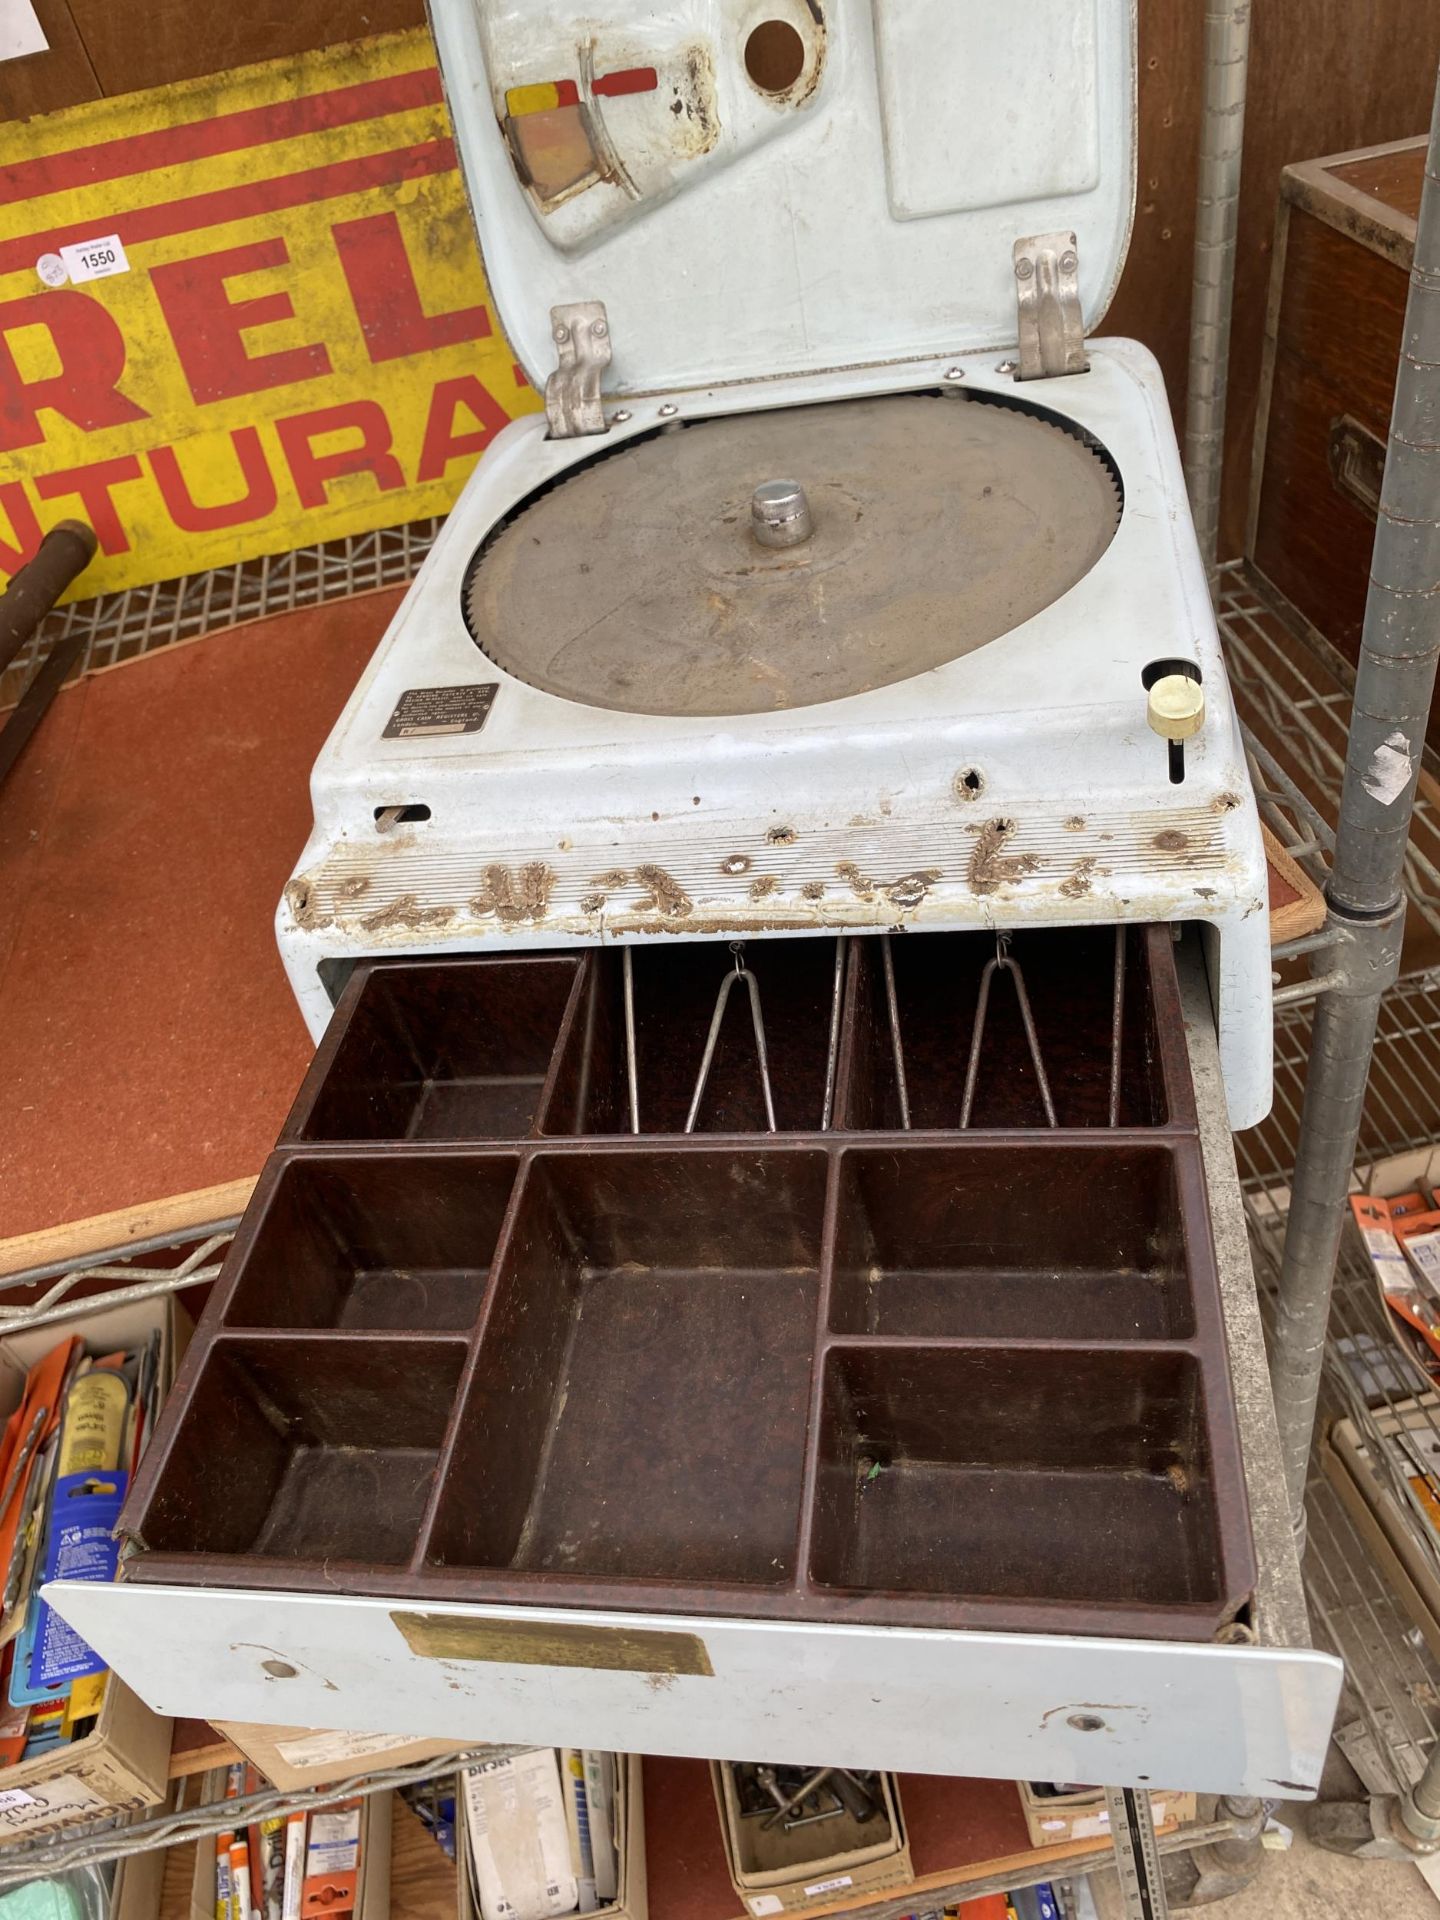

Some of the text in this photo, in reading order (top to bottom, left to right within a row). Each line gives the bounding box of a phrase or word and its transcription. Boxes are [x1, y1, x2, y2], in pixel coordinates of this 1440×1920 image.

[81, 249, 116, 269] 1550
[0, 363, 529, 577] NTURA
[268, 1829, 284, 1869] Drill
